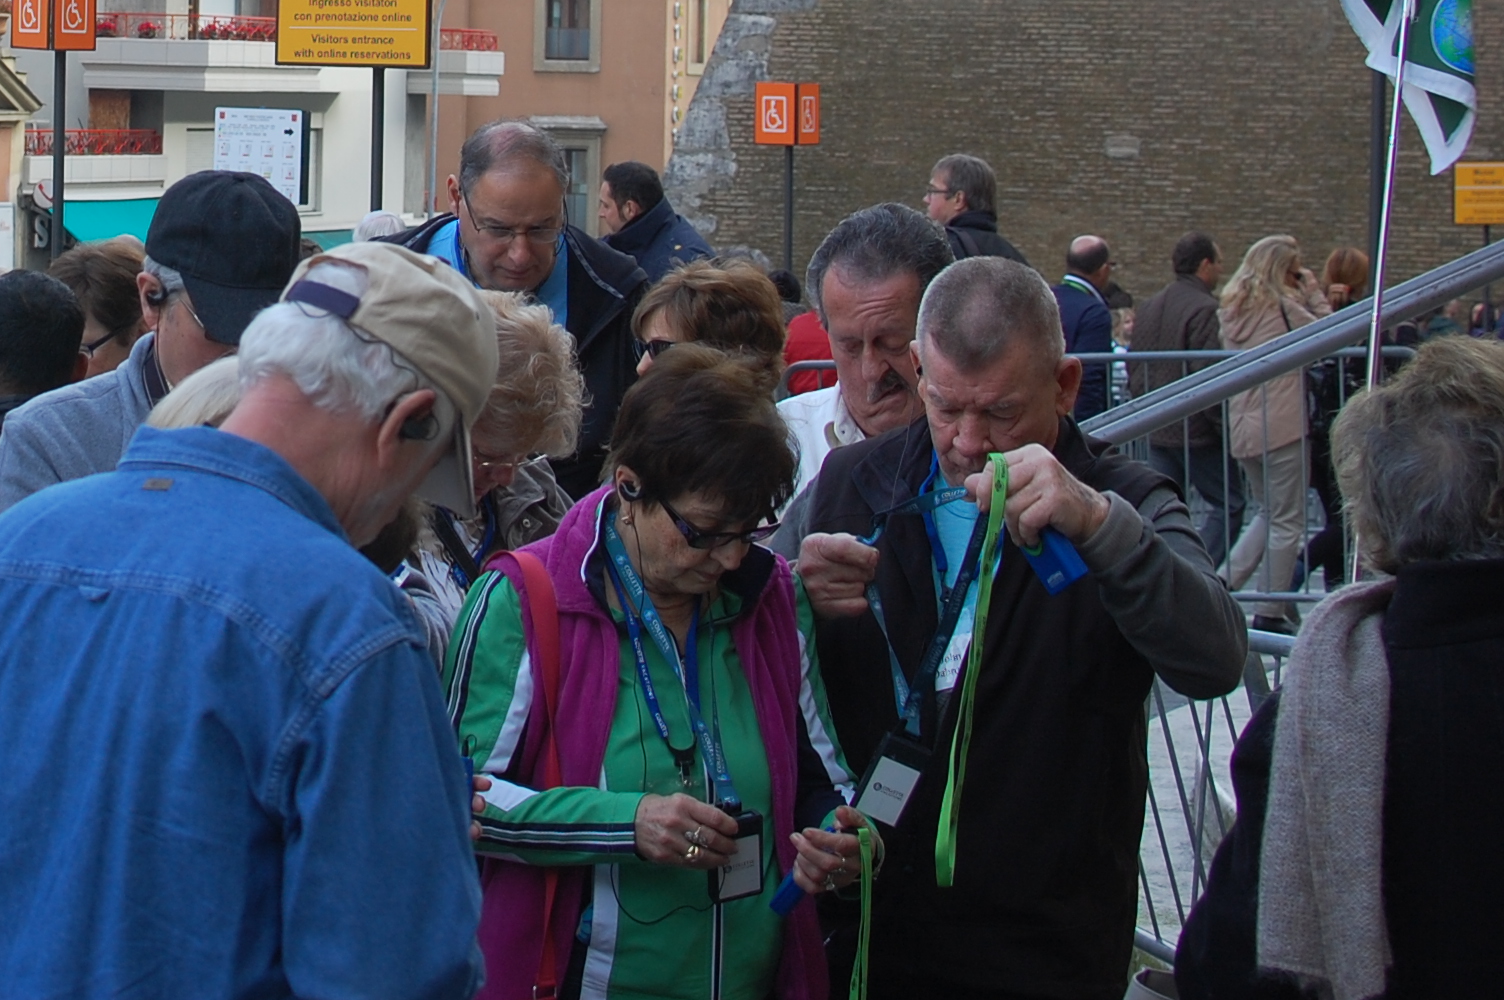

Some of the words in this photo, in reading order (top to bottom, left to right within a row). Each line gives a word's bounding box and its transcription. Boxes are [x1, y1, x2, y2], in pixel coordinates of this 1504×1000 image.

[294, 13, 312, 21] con
[314, 12, 379, 23] prenotazione
[381, 12, 412, 22] online
[311, 34, 349, 44] Visitors
[351, 35, 395, 45] entrance
[294, 48, 314, 58] with
[317, 48, 347, 59] online
[350, 49, 411, 60] reservations
[623, 564, 644, 596] COLLETTE
[652, 618, 670, 651] COLLETTE
